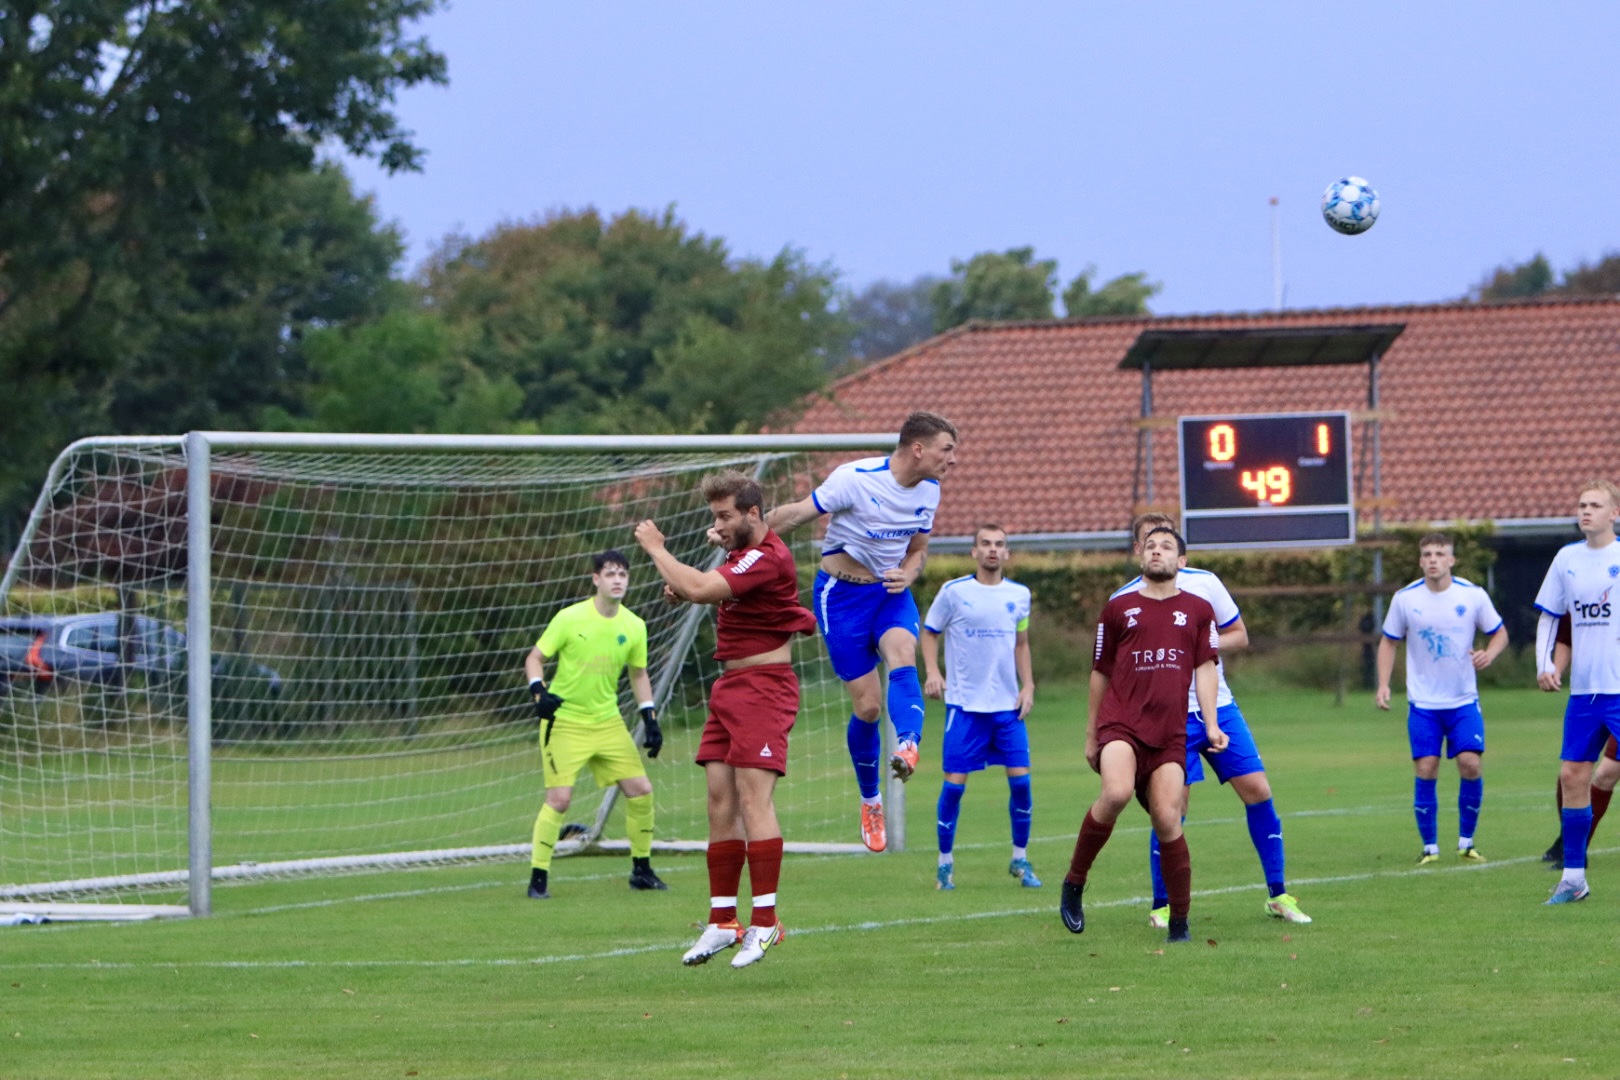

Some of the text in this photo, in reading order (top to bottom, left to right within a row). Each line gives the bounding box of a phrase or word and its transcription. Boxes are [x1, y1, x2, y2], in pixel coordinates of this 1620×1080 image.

[1208, 423, 1330, 461] 0 1
[1240, 465, 1291, 504] 49
[1131, 648, 1185, 664] TRØS
